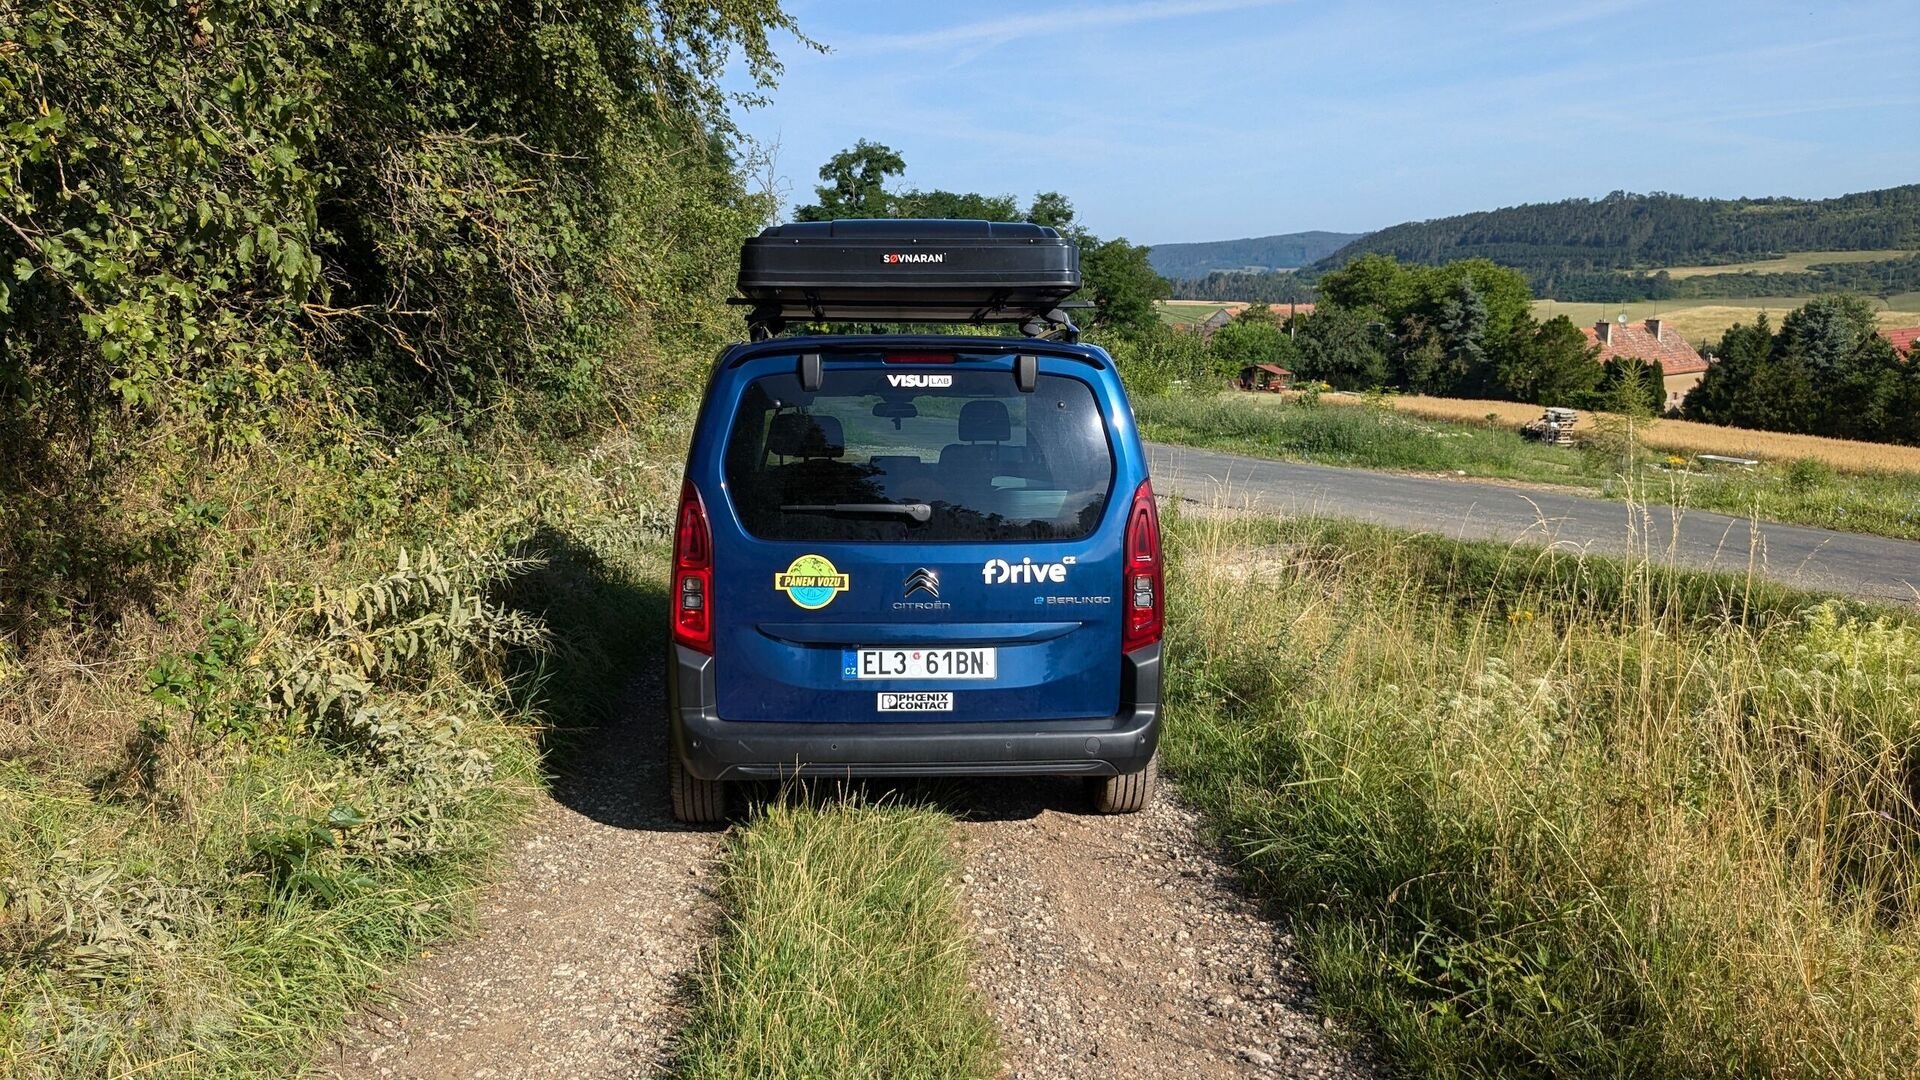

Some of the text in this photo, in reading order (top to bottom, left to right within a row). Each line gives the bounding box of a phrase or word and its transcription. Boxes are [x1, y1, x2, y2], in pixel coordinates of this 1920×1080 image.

[883, 254, 943, 263] SØVNARAN
[887, 375, 928, 387] VISU
[817, 577, 841, 587] VOZU
[892, 601, 951, 609] CITROËN
[845, 651, 984, 675] CZ EL3 61BN
[898, 701, 949, 710] CONTACT
